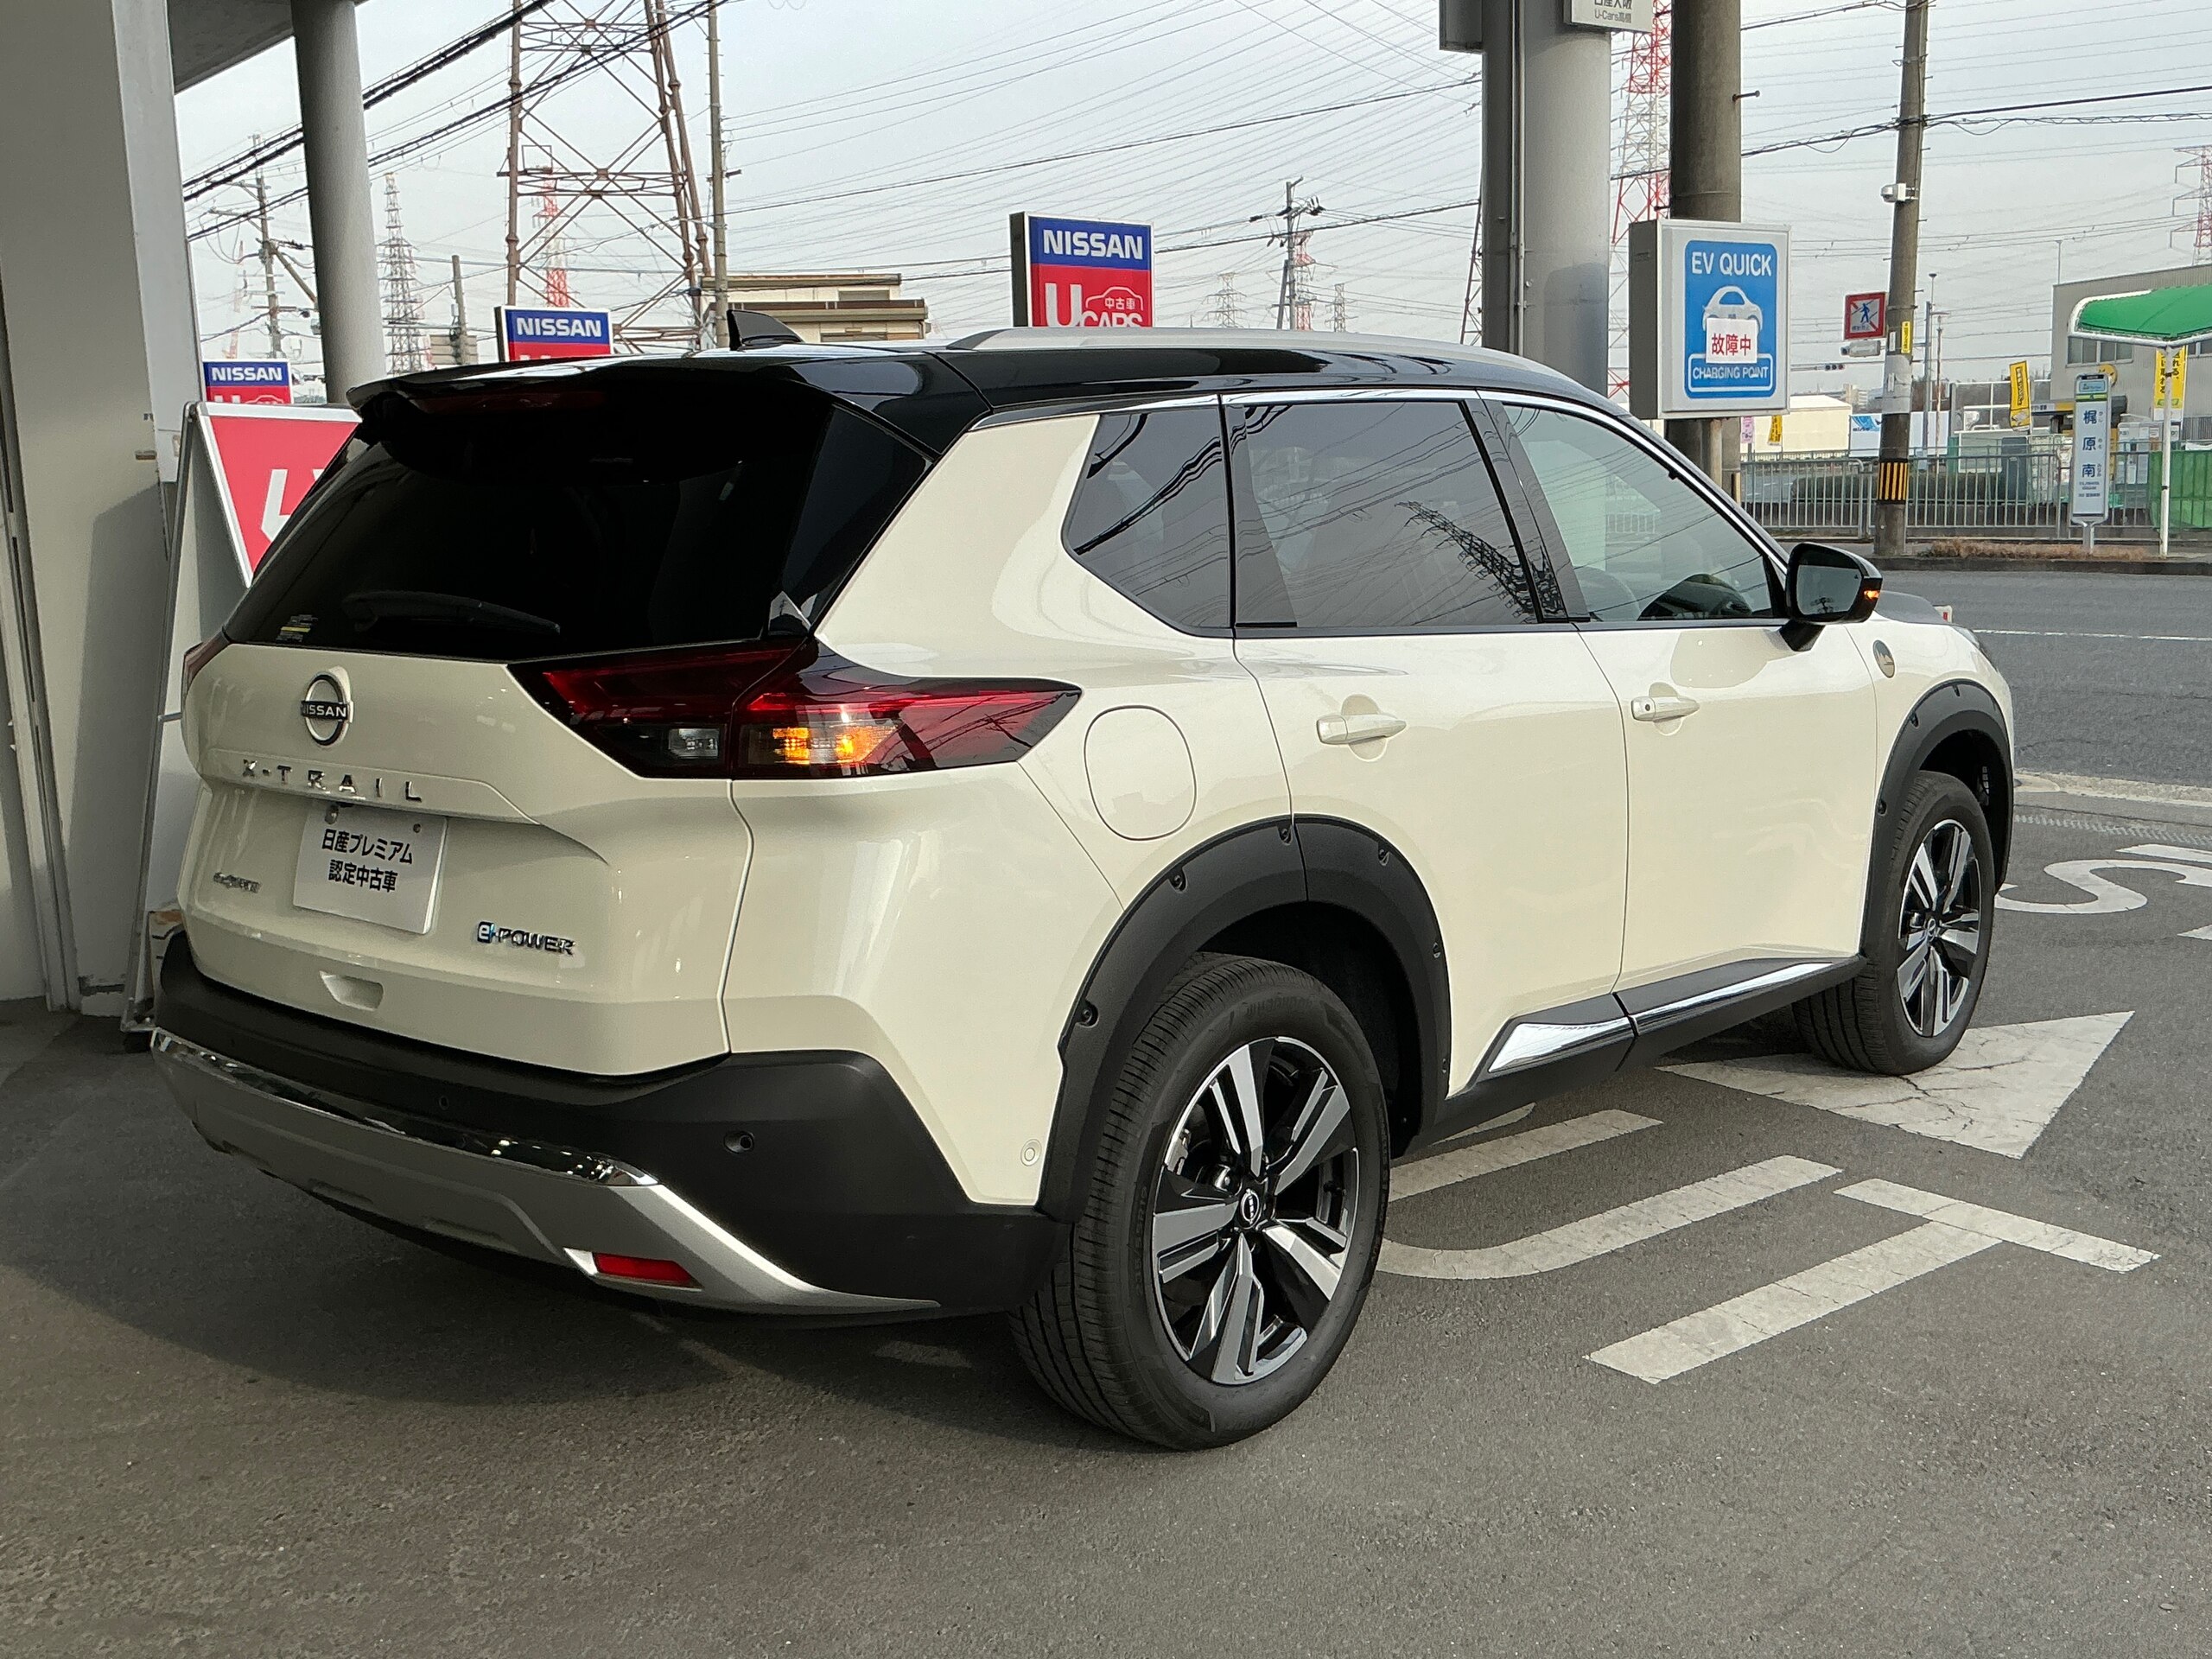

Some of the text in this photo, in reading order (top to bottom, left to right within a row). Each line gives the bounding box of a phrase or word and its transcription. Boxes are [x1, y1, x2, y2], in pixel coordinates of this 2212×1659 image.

[1043, 229, 1143, 260] NISSAN
[1691, 251, 1772, 276] EV QUICK
[1104, 297, 1136, 310] 中古車
[516, 317, 602, 337] NISSAN
[1711, 334, 1751, 356] 故障中
[211, 367, 283, 382] NISSAN
[1692, 366, 1769, 379] CHARGING POINT
[2082, 410, 2097, 478] 梶原南
[243, 759, 423, 803] X-TRAIL
[321, 829, 413, 865] 日産プレミアム
[327, 859, 398, 893] 認定中古車
